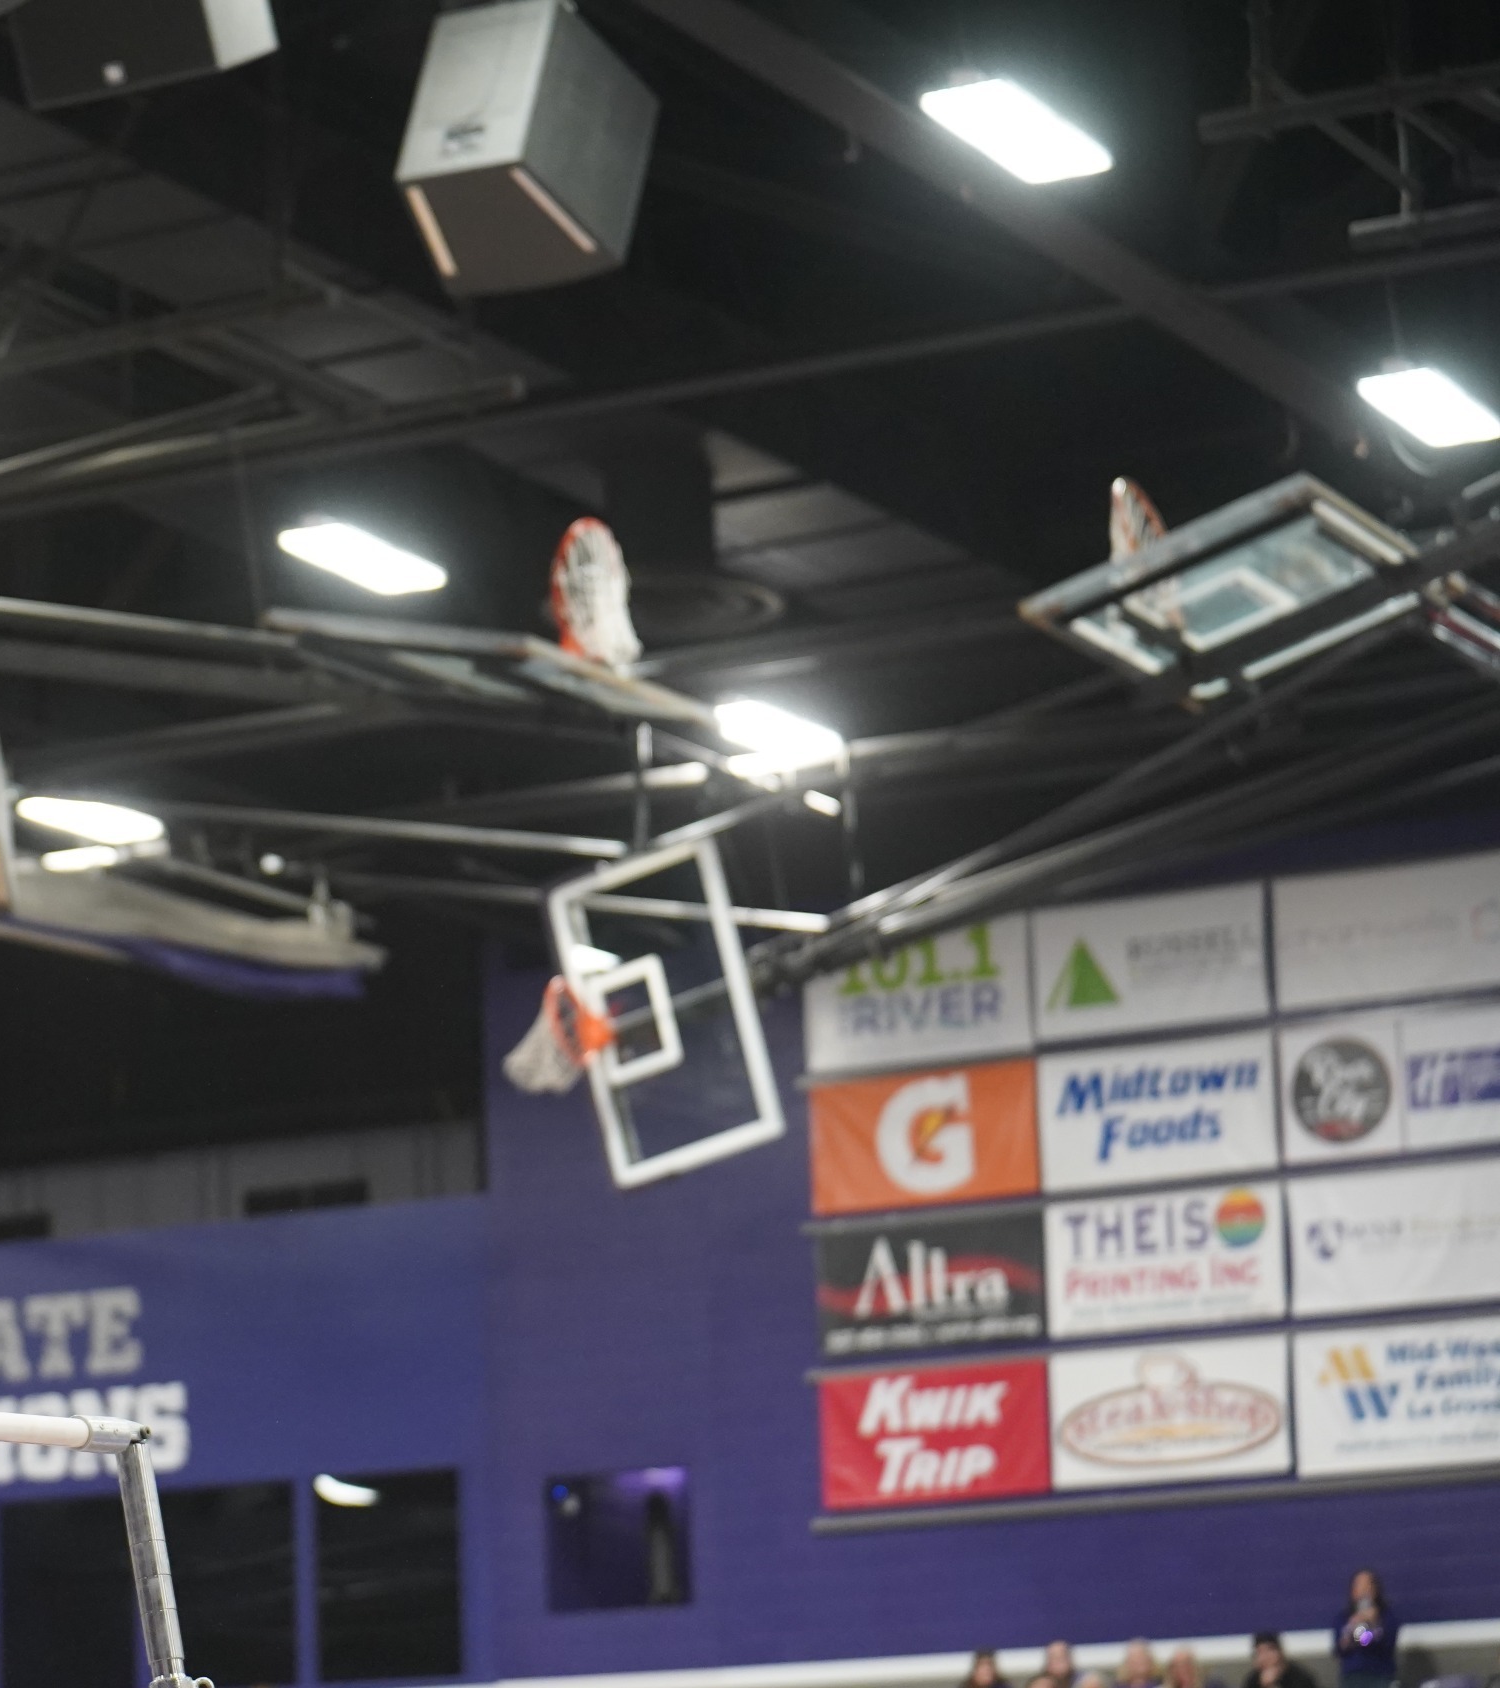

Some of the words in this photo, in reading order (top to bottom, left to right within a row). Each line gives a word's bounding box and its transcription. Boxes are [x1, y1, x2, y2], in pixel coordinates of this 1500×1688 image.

[852, 981, 1003, 1036] RIVER
[1056, 1061, 1260, 1118] Midtown
[1096, 1105, 1223, 1164] Foods
[1063, 1199, 1211, 1261] THEIS
[853, 1235, 1010, 1320] Altra
